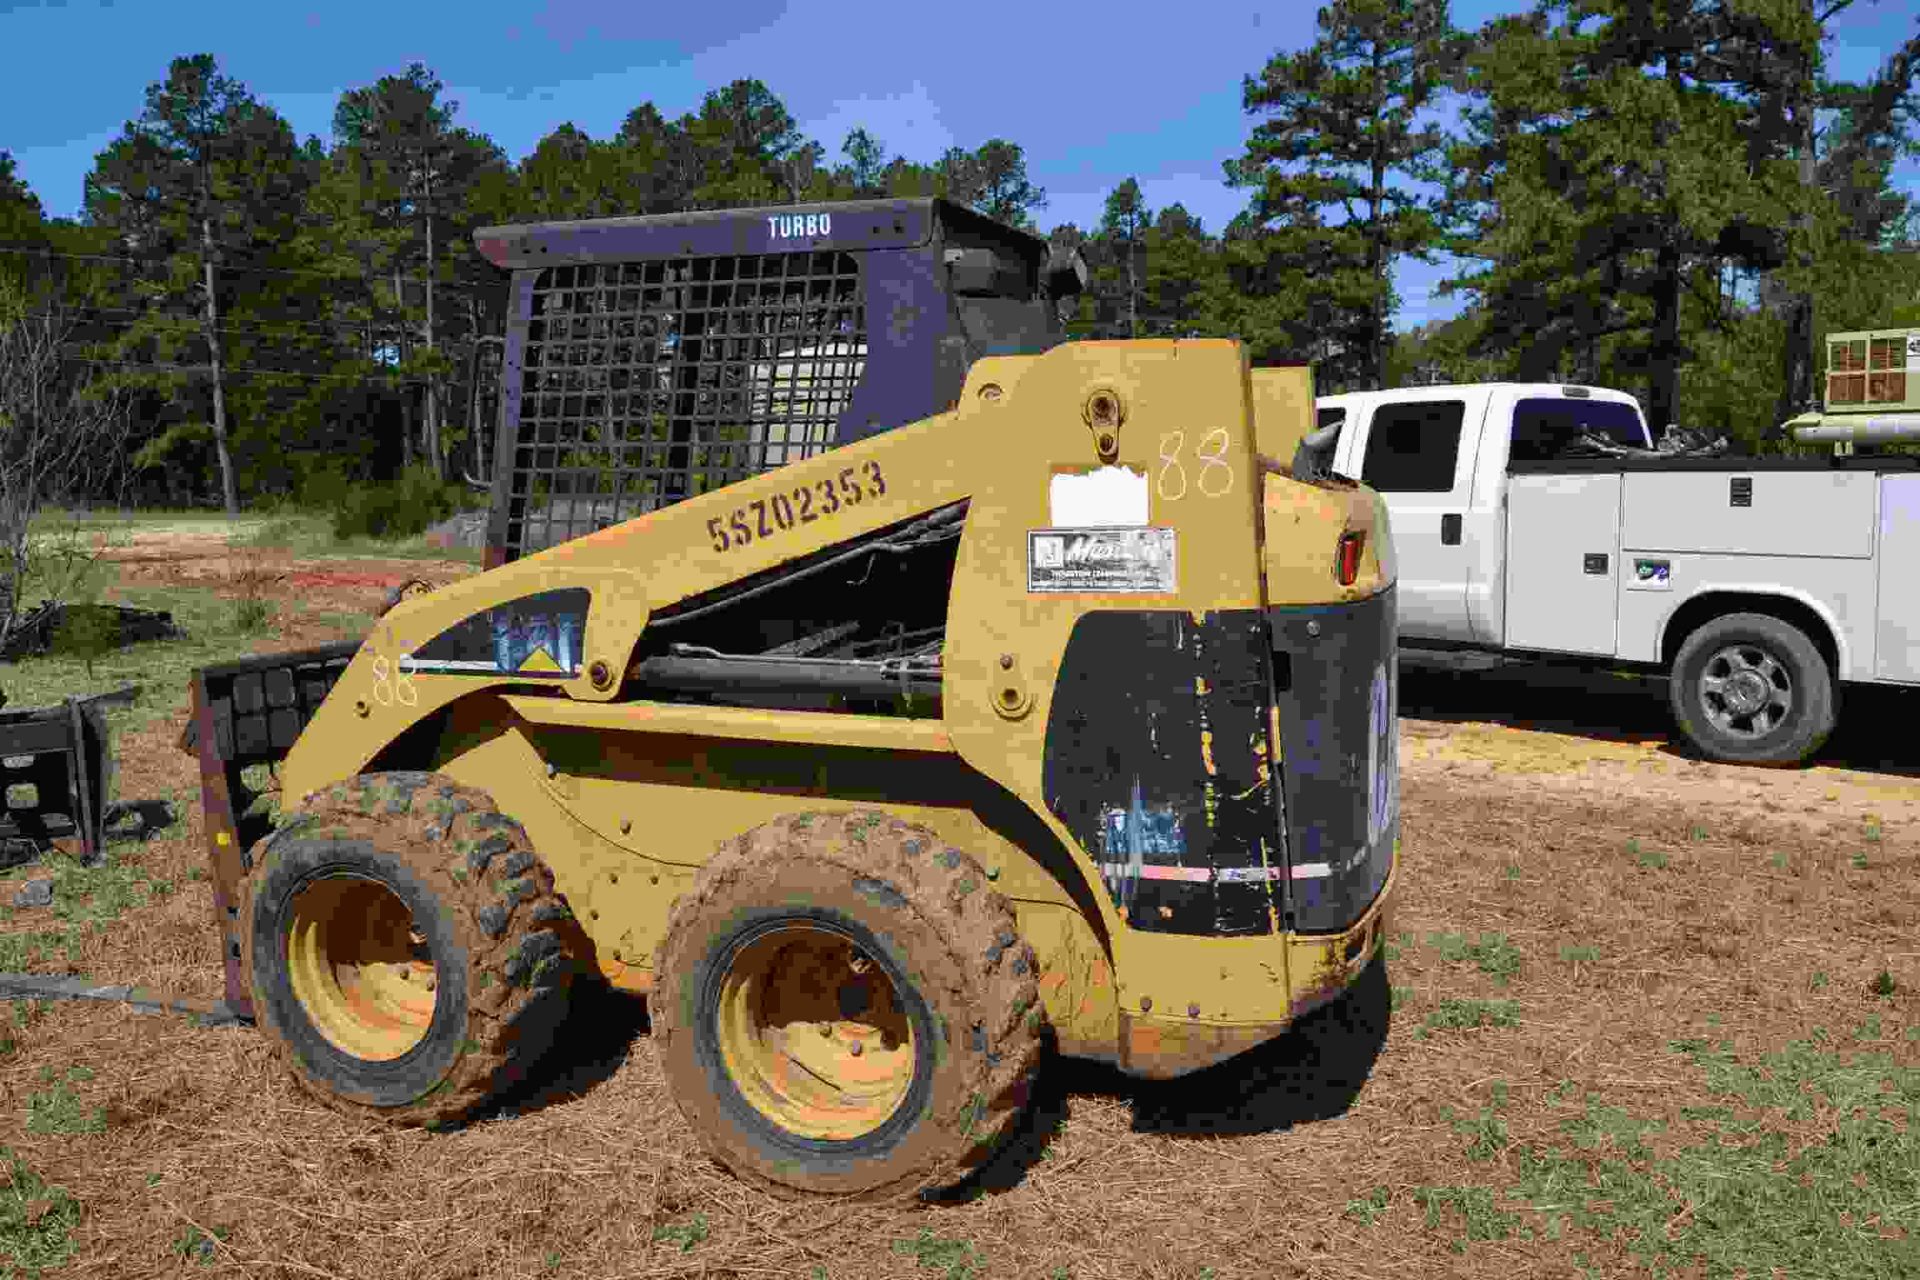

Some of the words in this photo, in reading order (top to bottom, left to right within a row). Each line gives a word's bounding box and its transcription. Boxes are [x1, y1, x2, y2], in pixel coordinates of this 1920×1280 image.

[768, 213, 831, 239] TURBO
[1158, 427, 1234, 500] 88
[707, 460, 886, 552] 5SZ02353
